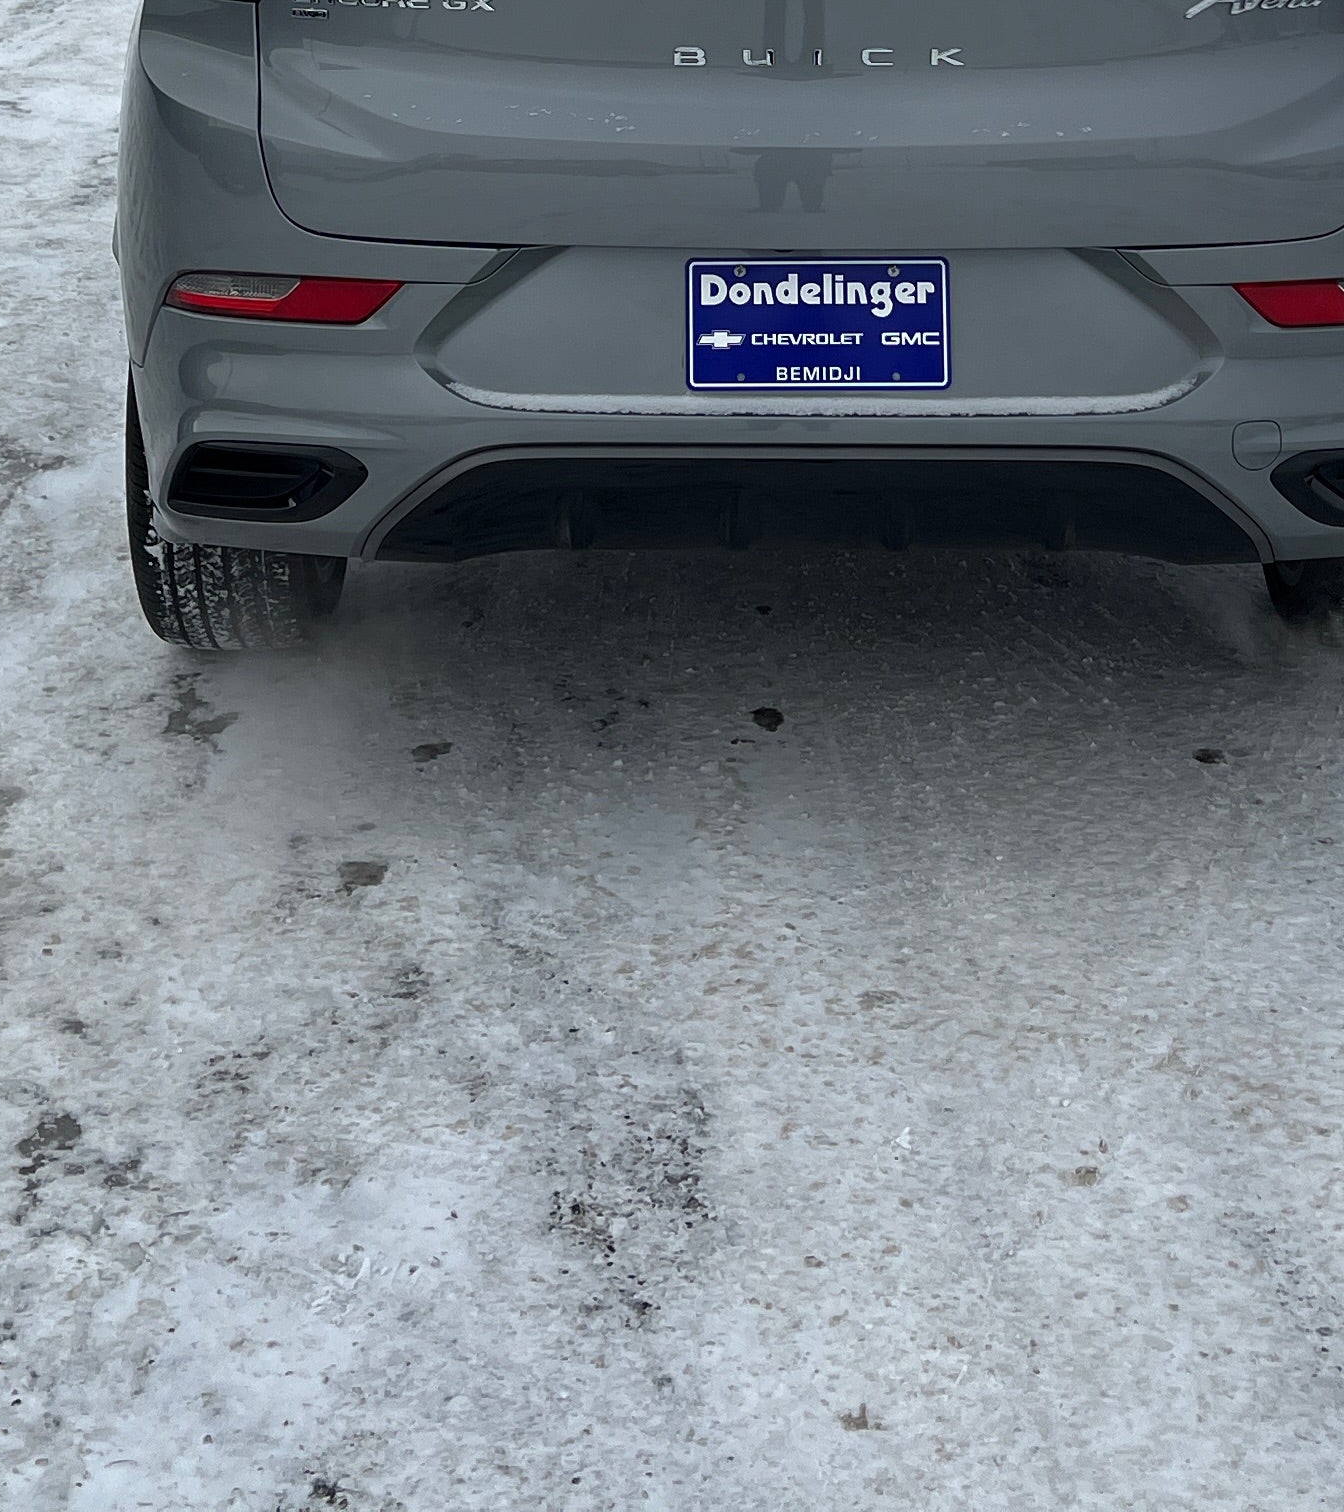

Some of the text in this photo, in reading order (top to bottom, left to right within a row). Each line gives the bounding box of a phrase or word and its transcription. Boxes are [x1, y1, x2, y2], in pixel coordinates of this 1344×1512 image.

[673, 46, 965, 66] BUICK
[700, 273, 935, 318] Dondelinger
[751, 332, 940, 345] CHEVROLET GMC
[776, 366, 861, 381] BEMIDJI
